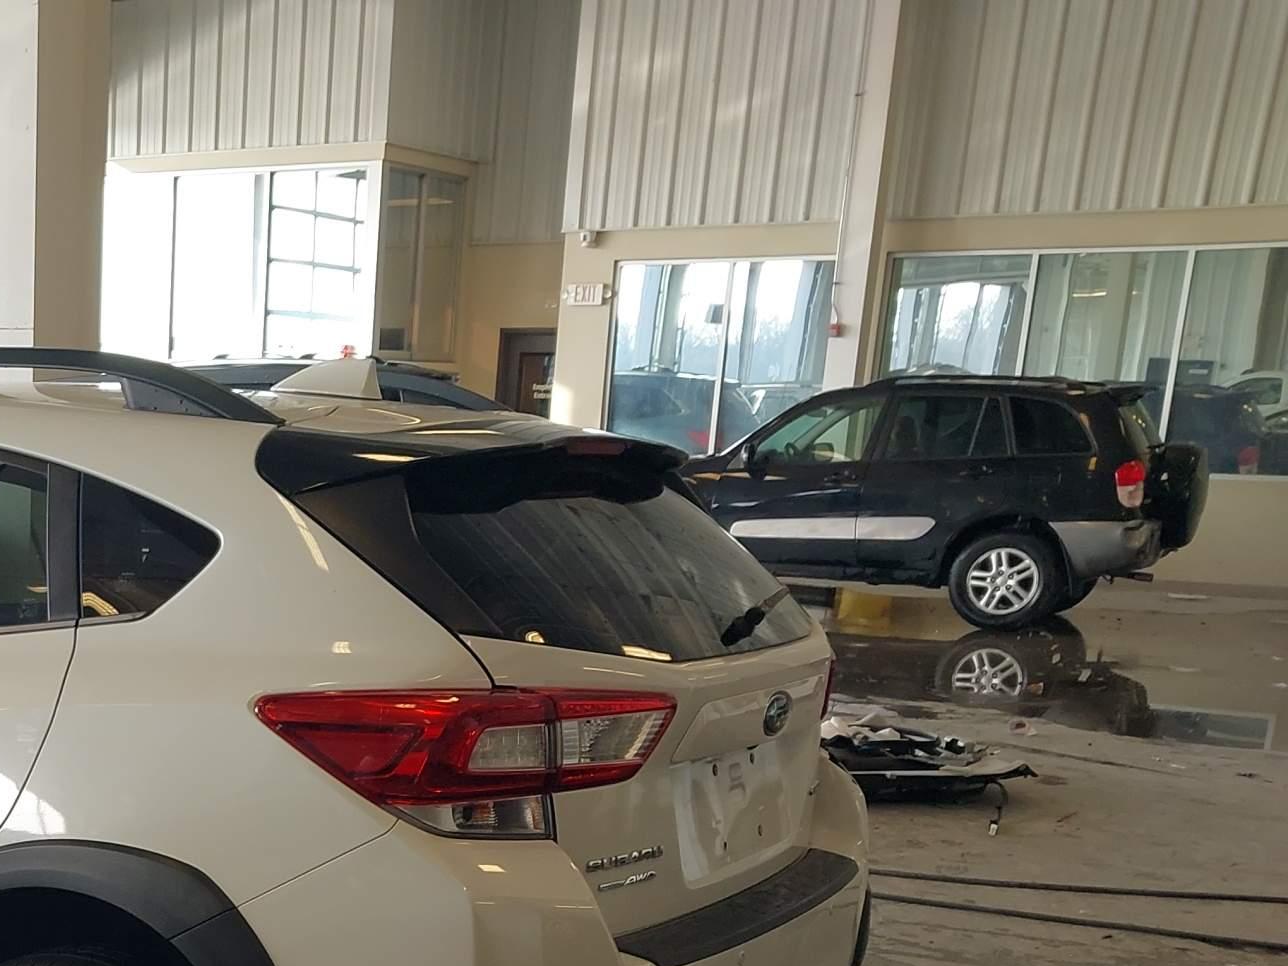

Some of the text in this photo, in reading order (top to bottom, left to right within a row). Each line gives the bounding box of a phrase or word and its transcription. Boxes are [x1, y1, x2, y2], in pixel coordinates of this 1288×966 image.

[574, 285, 598, 303] EXIT
[585, 845, 664, 873] SUBARU
[623, 870, 657, 886] AWD
